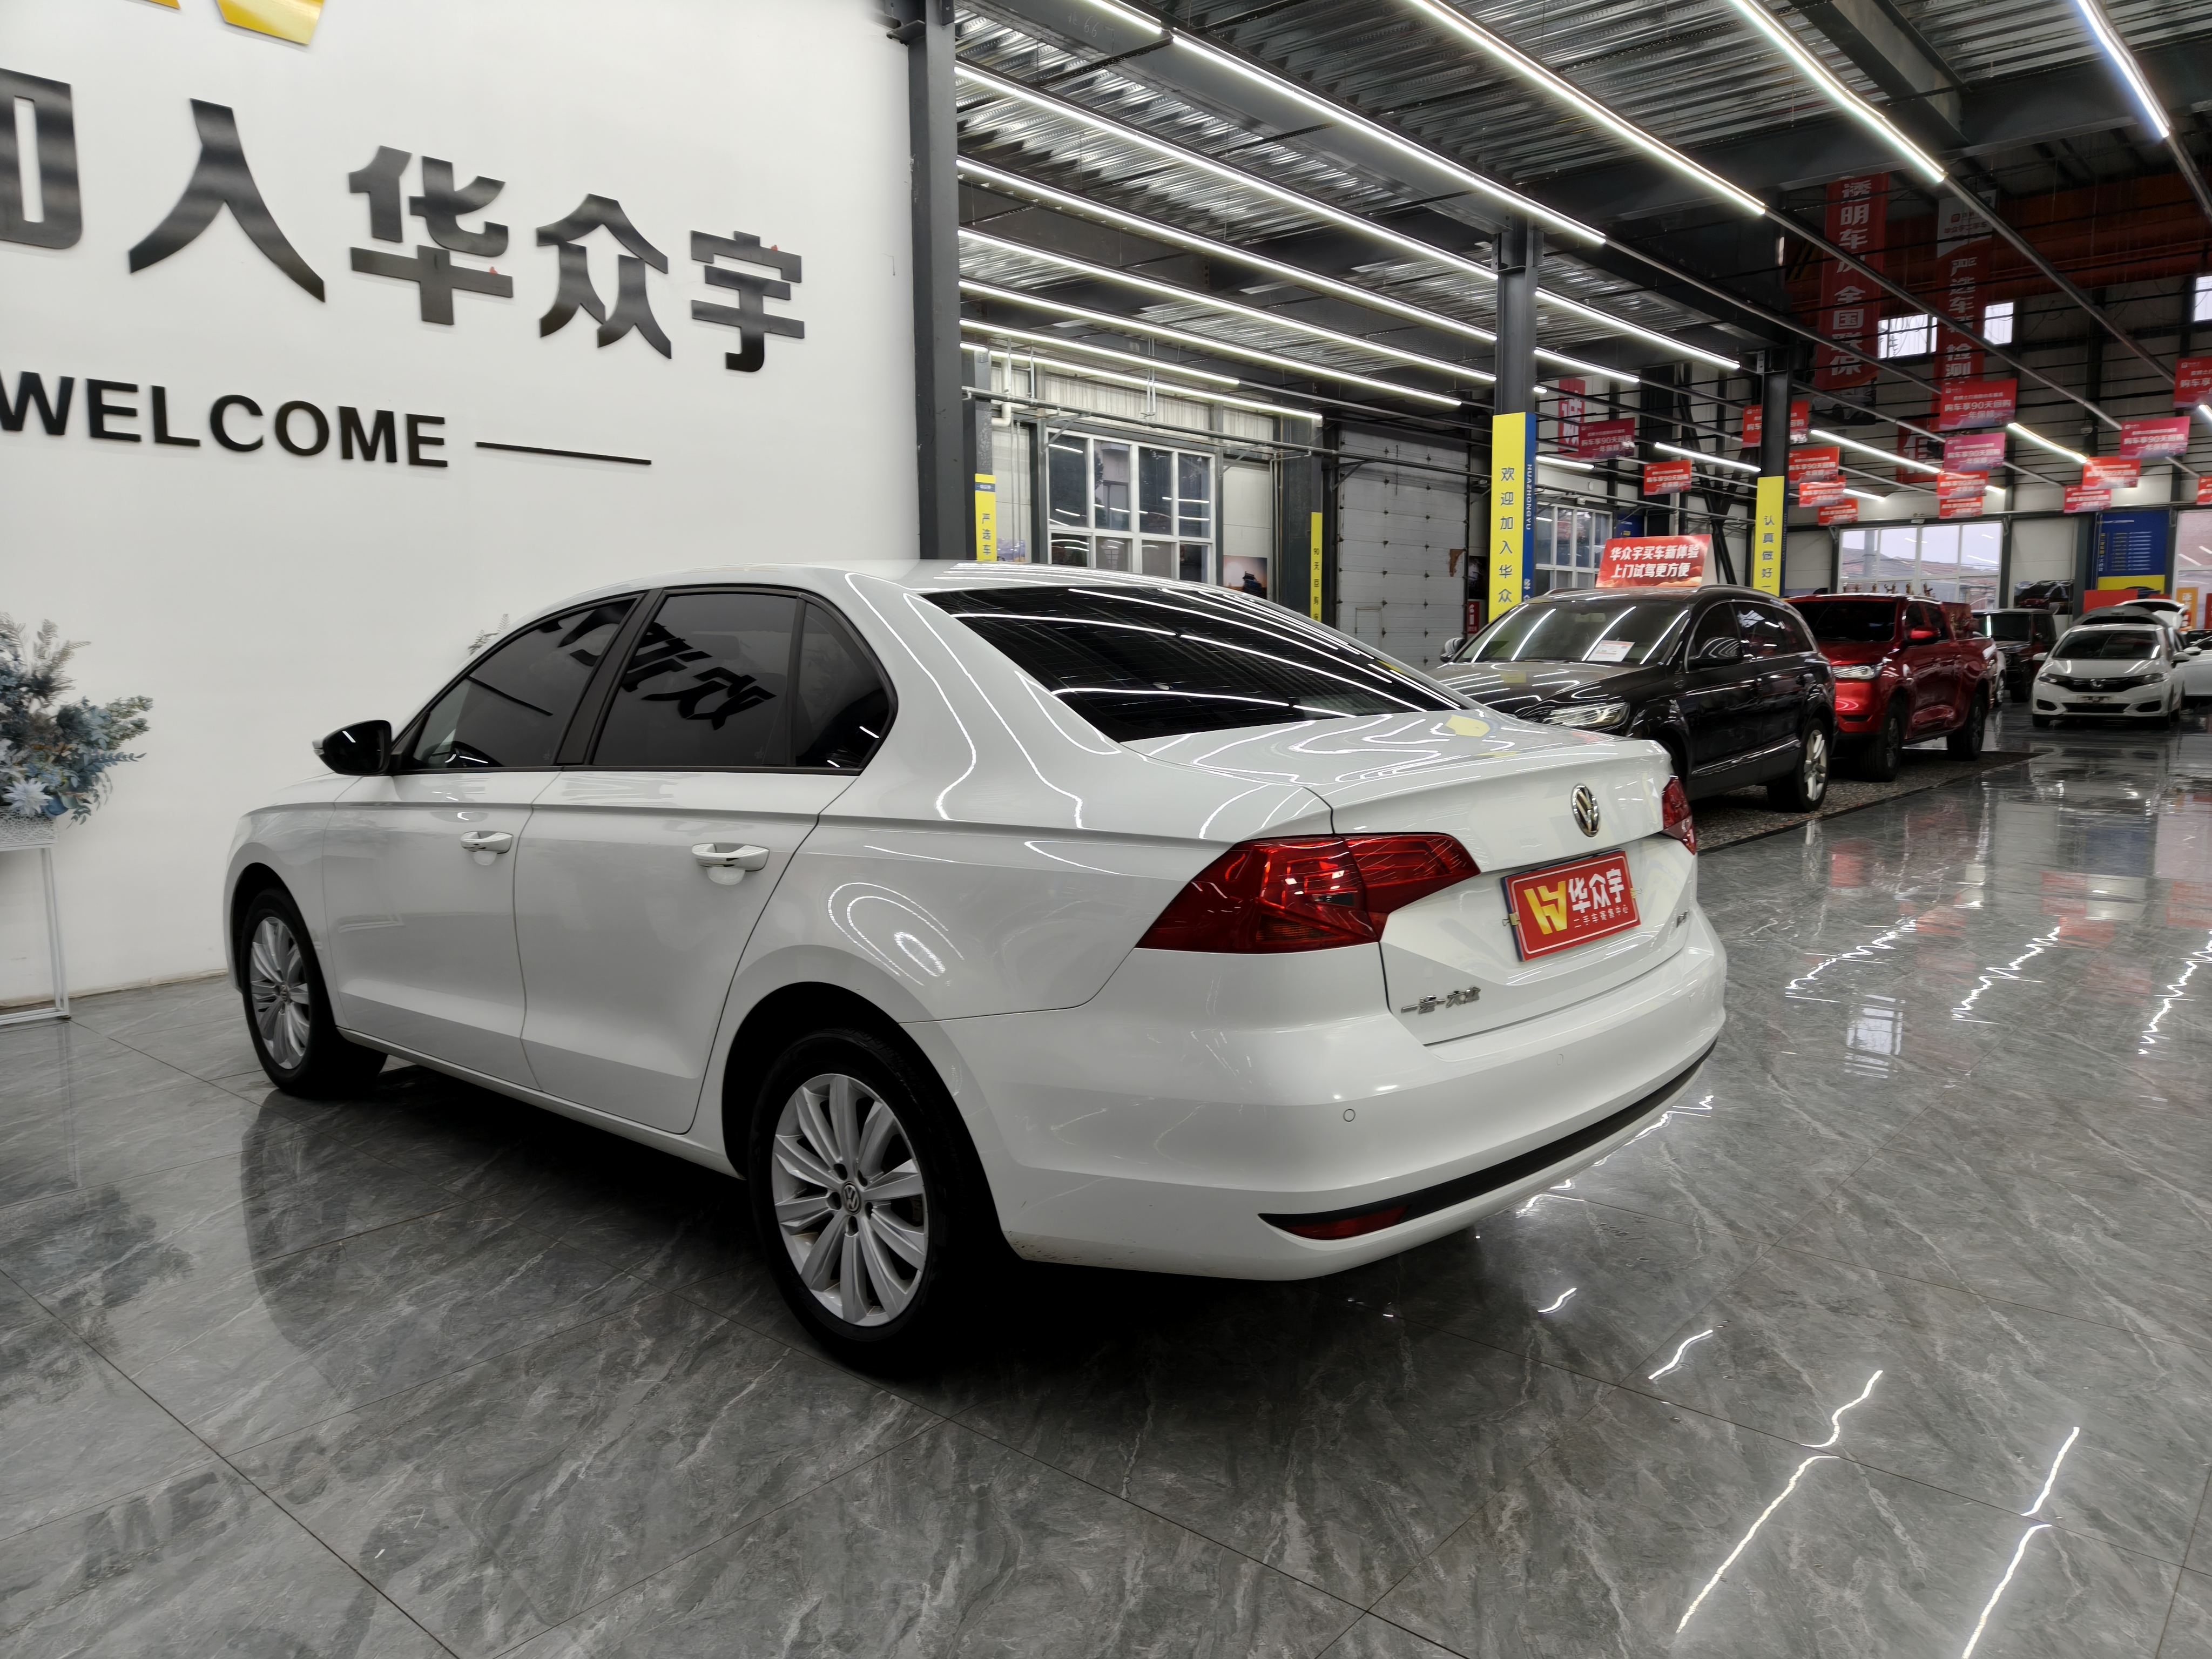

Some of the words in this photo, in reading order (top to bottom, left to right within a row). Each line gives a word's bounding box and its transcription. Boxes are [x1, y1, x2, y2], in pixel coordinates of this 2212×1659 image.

[0, 370, 449, 468] WELCOME
[982, 513, 992, 561] 严选车
[1498, 467, 1515, 603] 欢迎加入华众
[1609, 544, 1701, 561] 华众宇买车新体验
[1610, 562, 1691, 578] 上门试驾更方便
[1568, 868, 1625, 913] 华众宇
